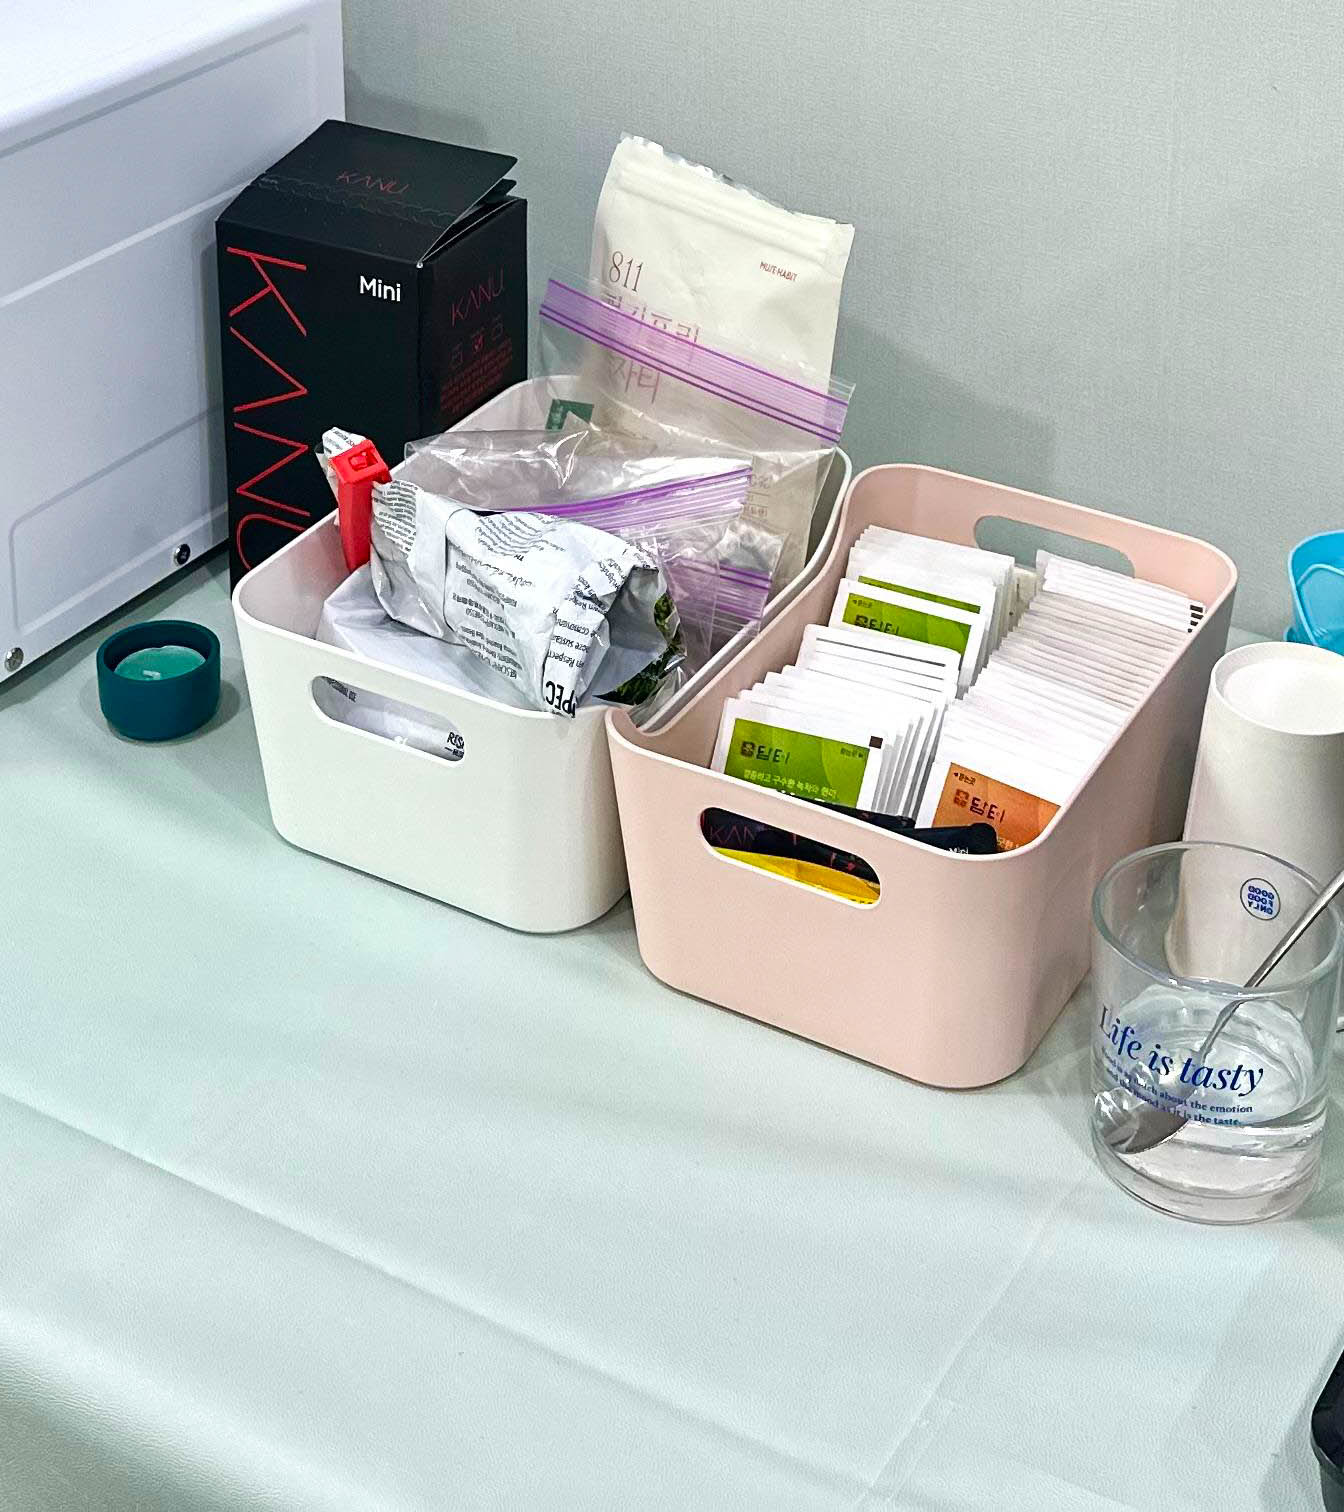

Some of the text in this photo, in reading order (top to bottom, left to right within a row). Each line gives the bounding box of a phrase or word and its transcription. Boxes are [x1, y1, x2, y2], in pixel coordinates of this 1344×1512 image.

[336, 170, 410, 194] KANU
[609, 250, 644, 293] 811
[359, 276, 401, 302] Mini
[451, 267, 505, 328] KANU
[821, 785, 837, 799] 현미
[1100, 1005, 1264, 1098] Life is tasty
[1159, 1090, 1188, 1107] about
[1190, 1100, 1208, 1111] the
[1210, 1104, 1254, 1114] emotion
[1193, 1113, 1212, 1124] the
